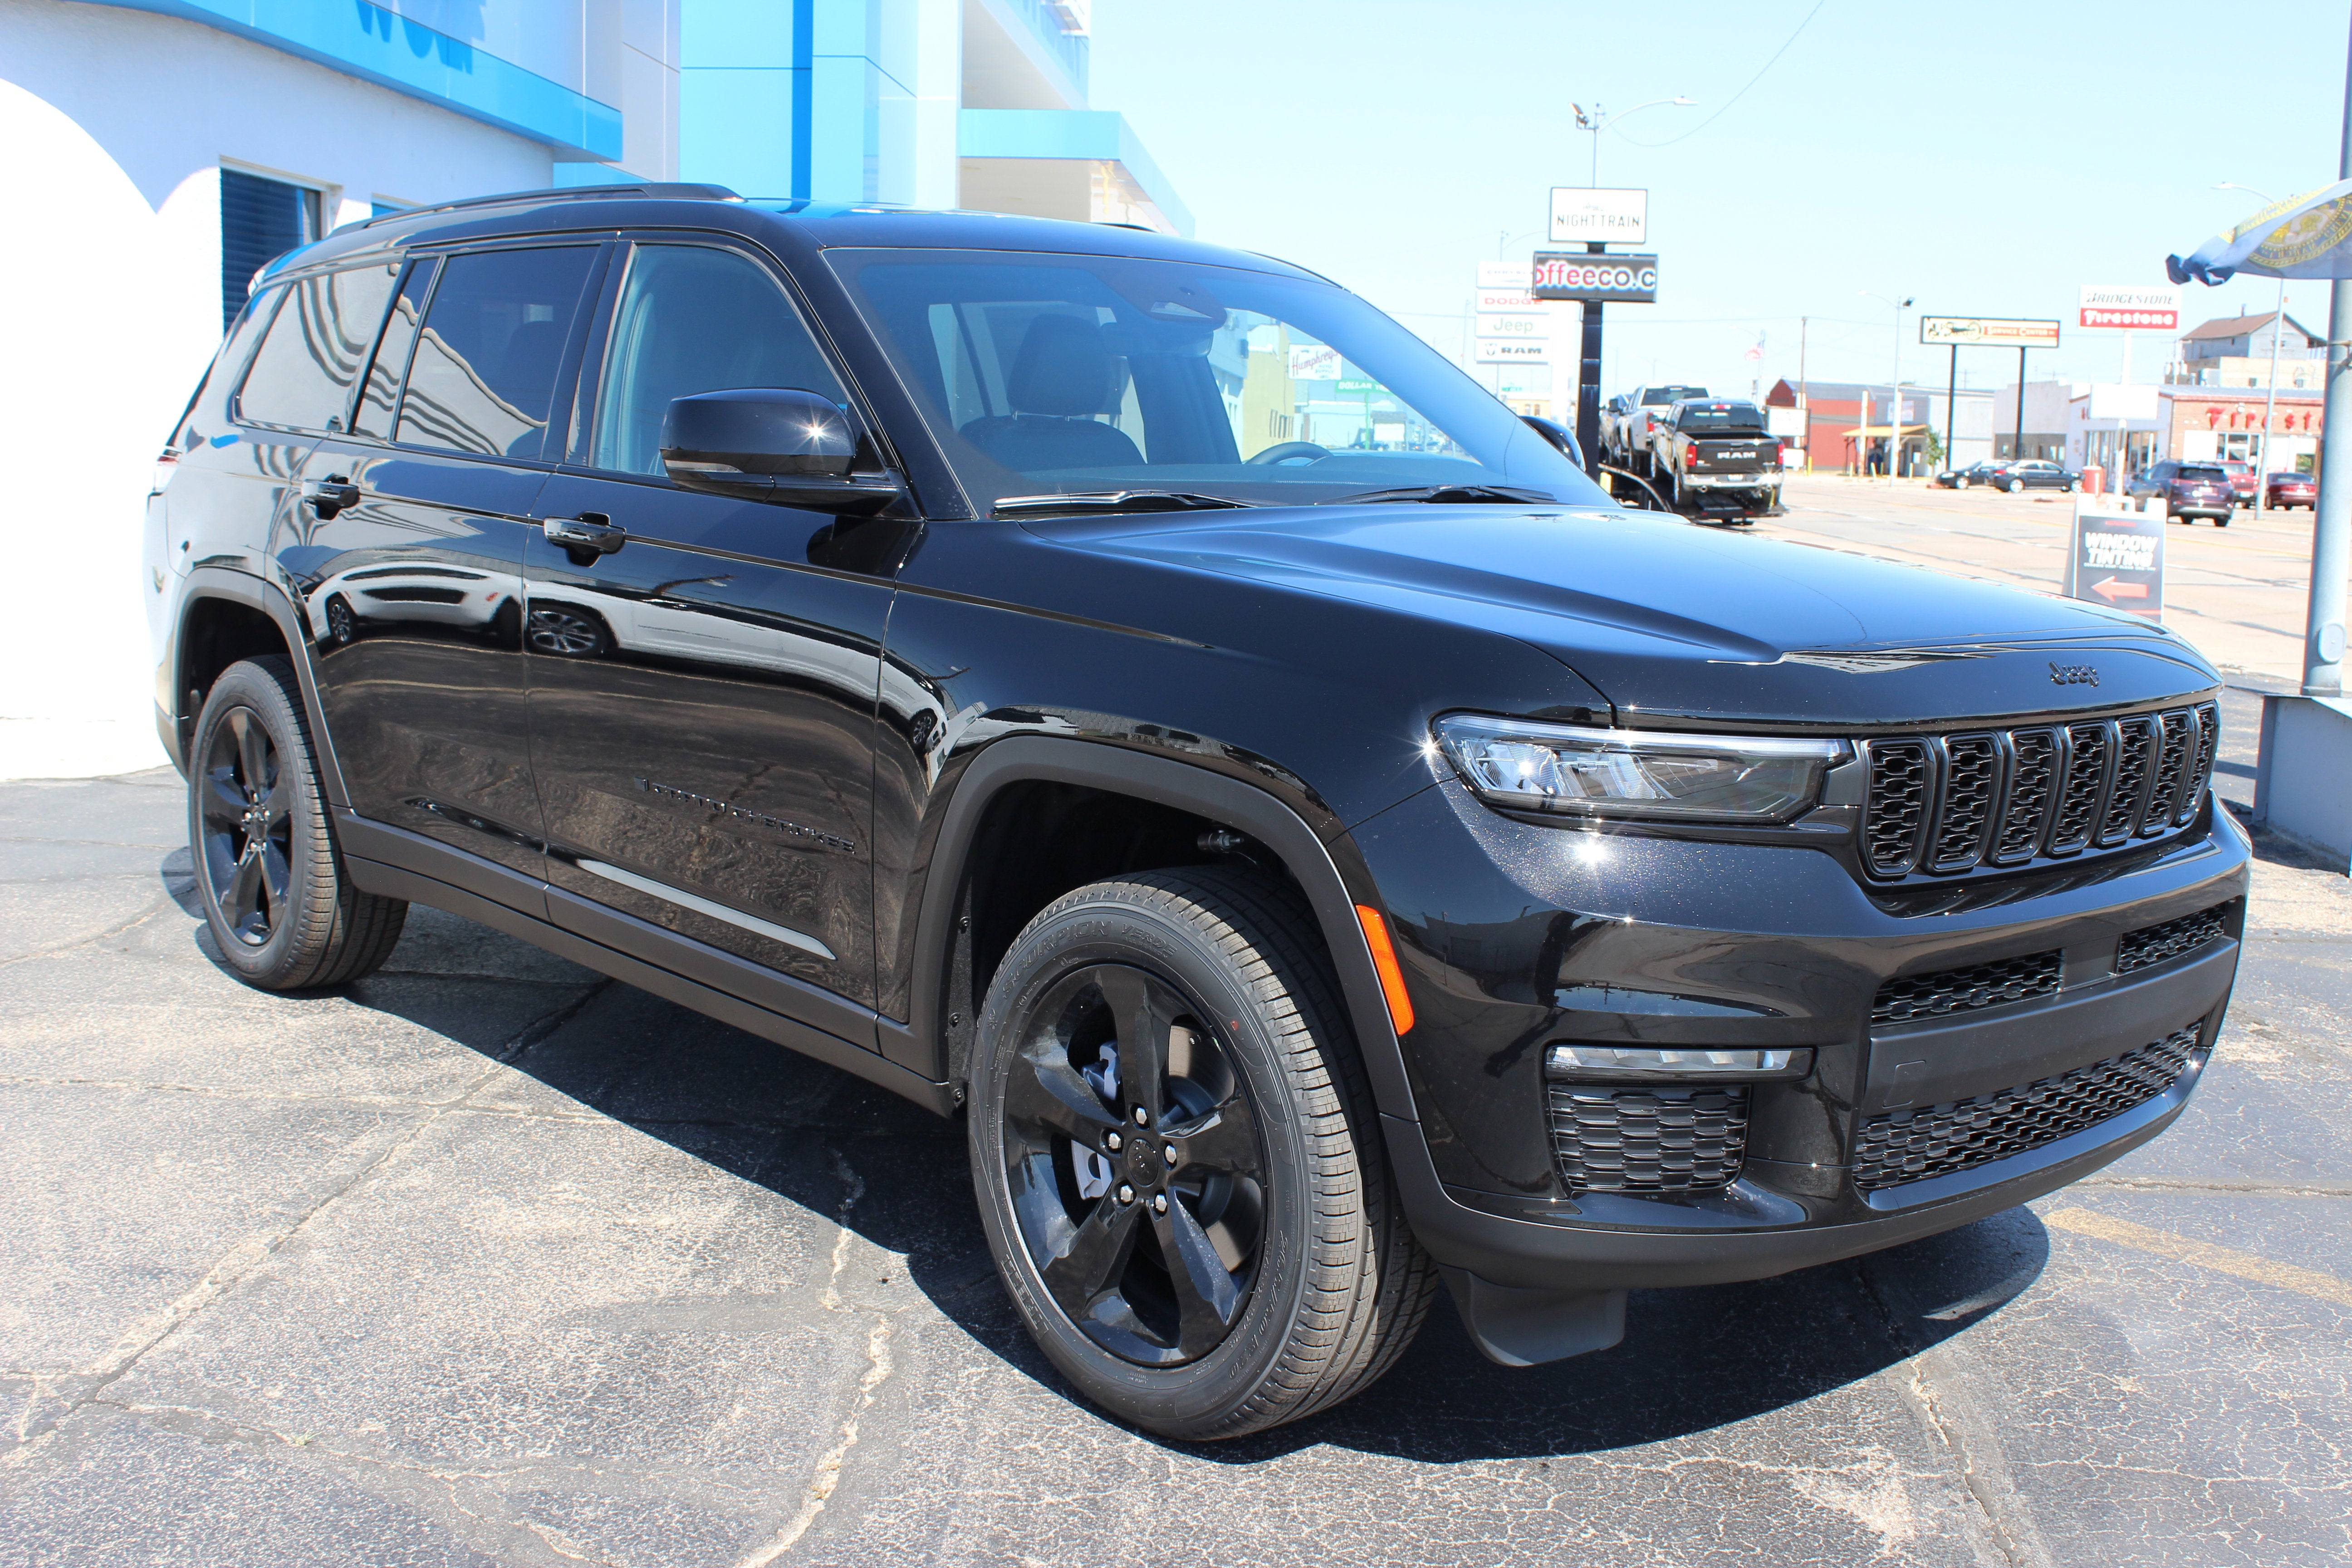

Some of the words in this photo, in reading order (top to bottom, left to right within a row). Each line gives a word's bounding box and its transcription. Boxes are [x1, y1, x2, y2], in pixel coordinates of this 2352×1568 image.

[1557, 215, 1596, 227] NIGHT
[1601, 216, 1640, 227] TRAIN
[2086, 292, 2174, 305] BRIDGESTONE
[1493, 318, 1534, 334] Jeep
[2084, 310, 2174, 326] Firestone
[1338, 381, 1372, 390] DOLLAR
[2085, 532, 2159, 552] WINDOW
[2088, 548, 2153, 567] TINTING
[1003, 921, 1112, 997] SCORPION
[1121, 923, 1177, 956] VERDE
